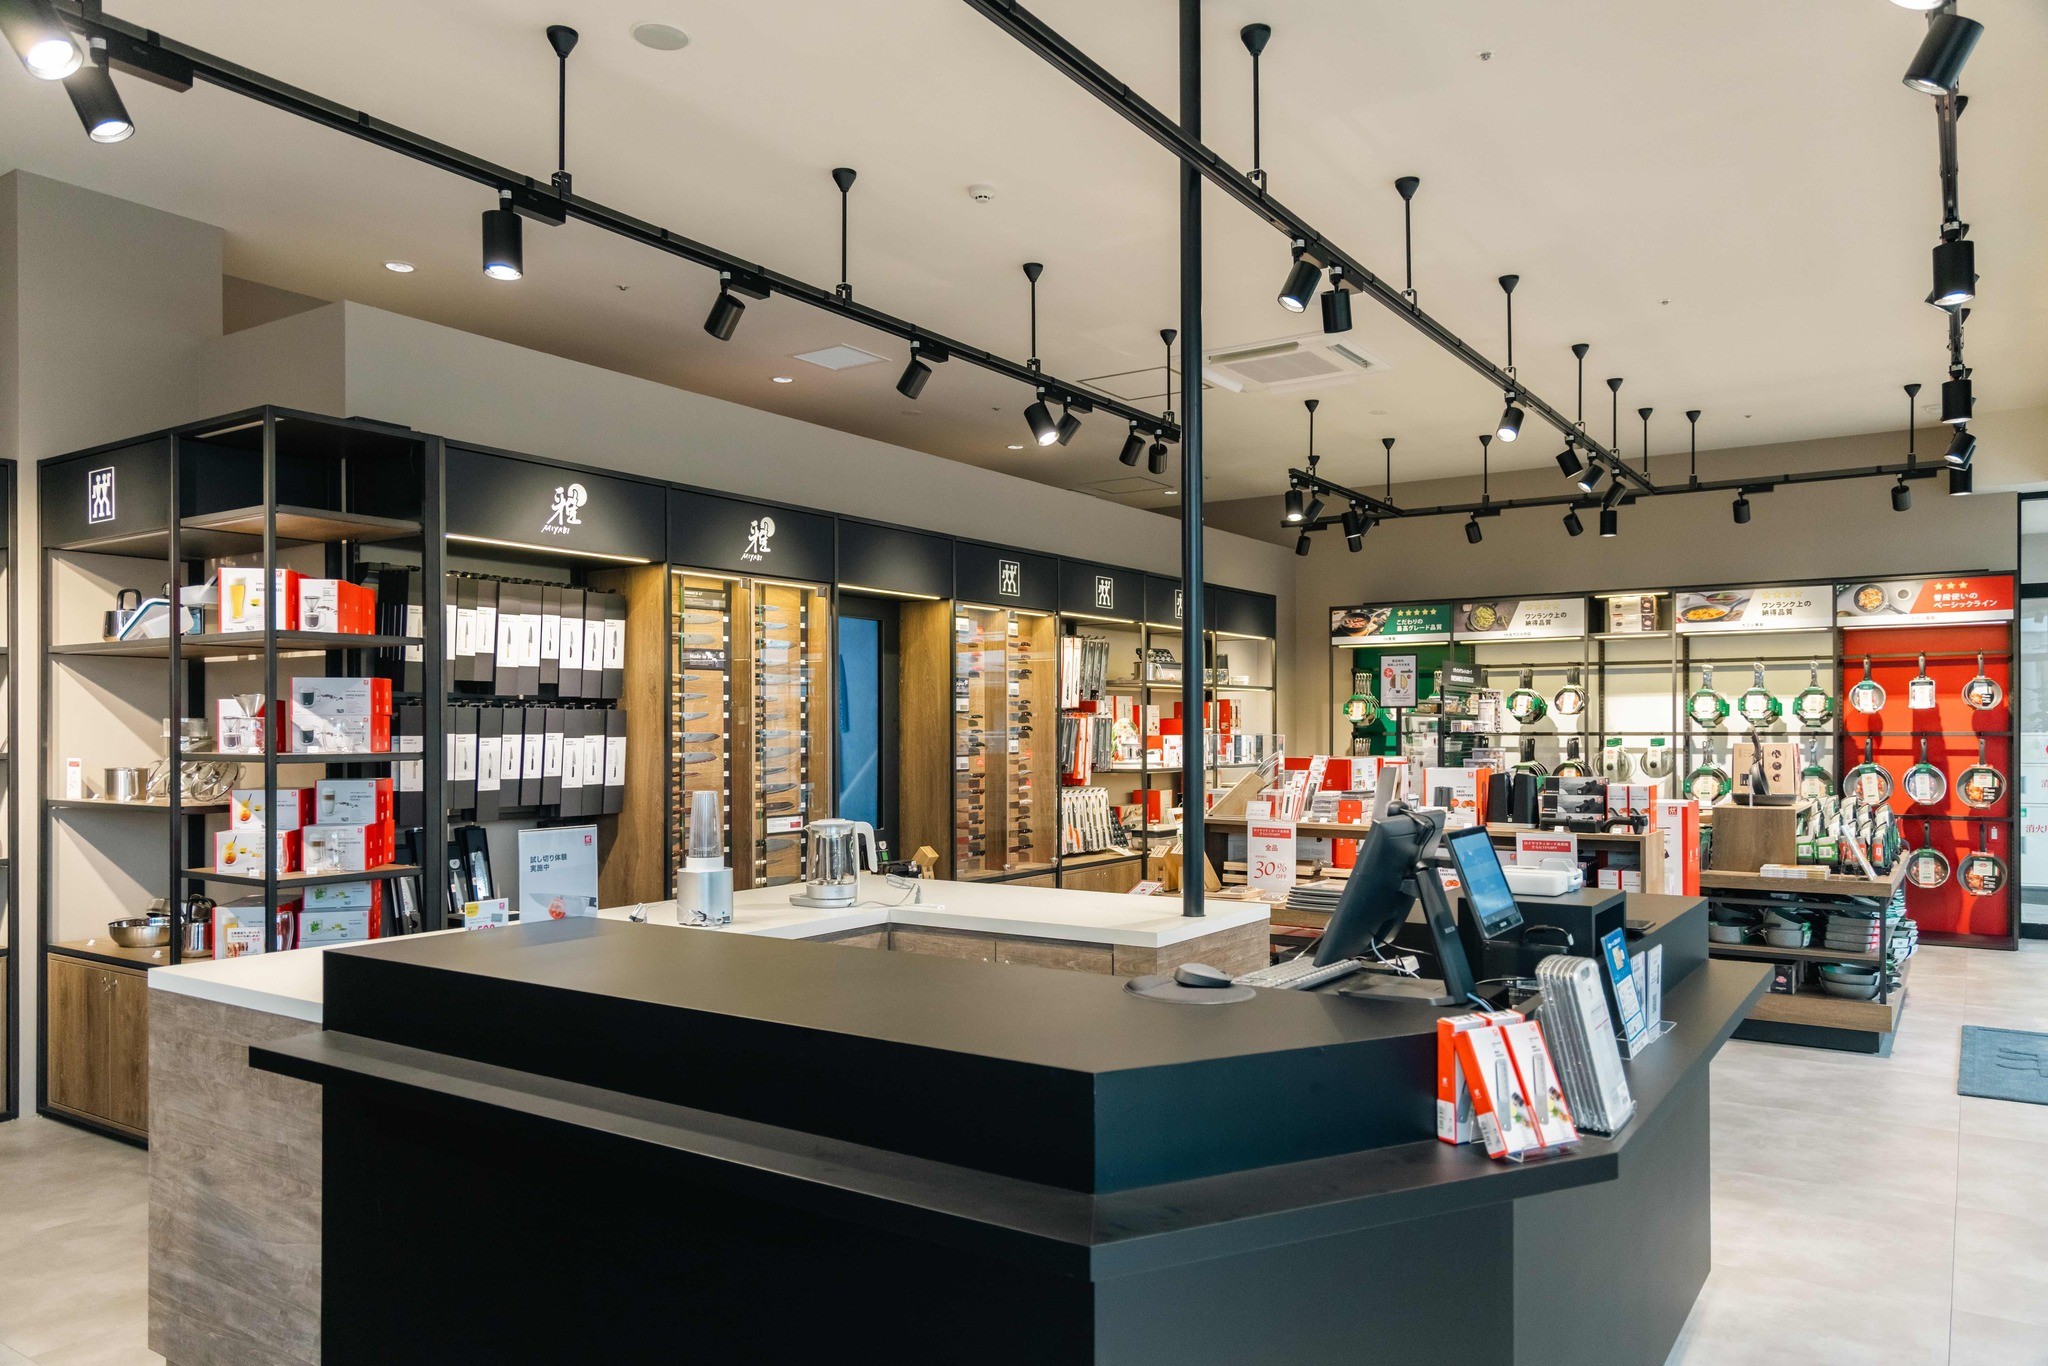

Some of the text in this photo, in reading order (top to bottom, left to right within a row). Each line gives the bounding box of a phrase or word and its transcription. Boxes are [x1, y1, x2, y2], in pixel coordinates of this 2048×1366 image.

[1761, 600, 1812, 609] ワンランク上の
[1933, 600, 1998, 609] ベーシックライン
[1525, 611, 1567, 620] ワンランク上の
[1396, 618, 1424, 626] こだわりの
[1396, 623, 1443, 632] 最高グレード品質
[1265, 844, 1278, 852] 全品
[530, 853, 567, 863] 試し切り体験
[530, 863, 550, 872] 実施中
